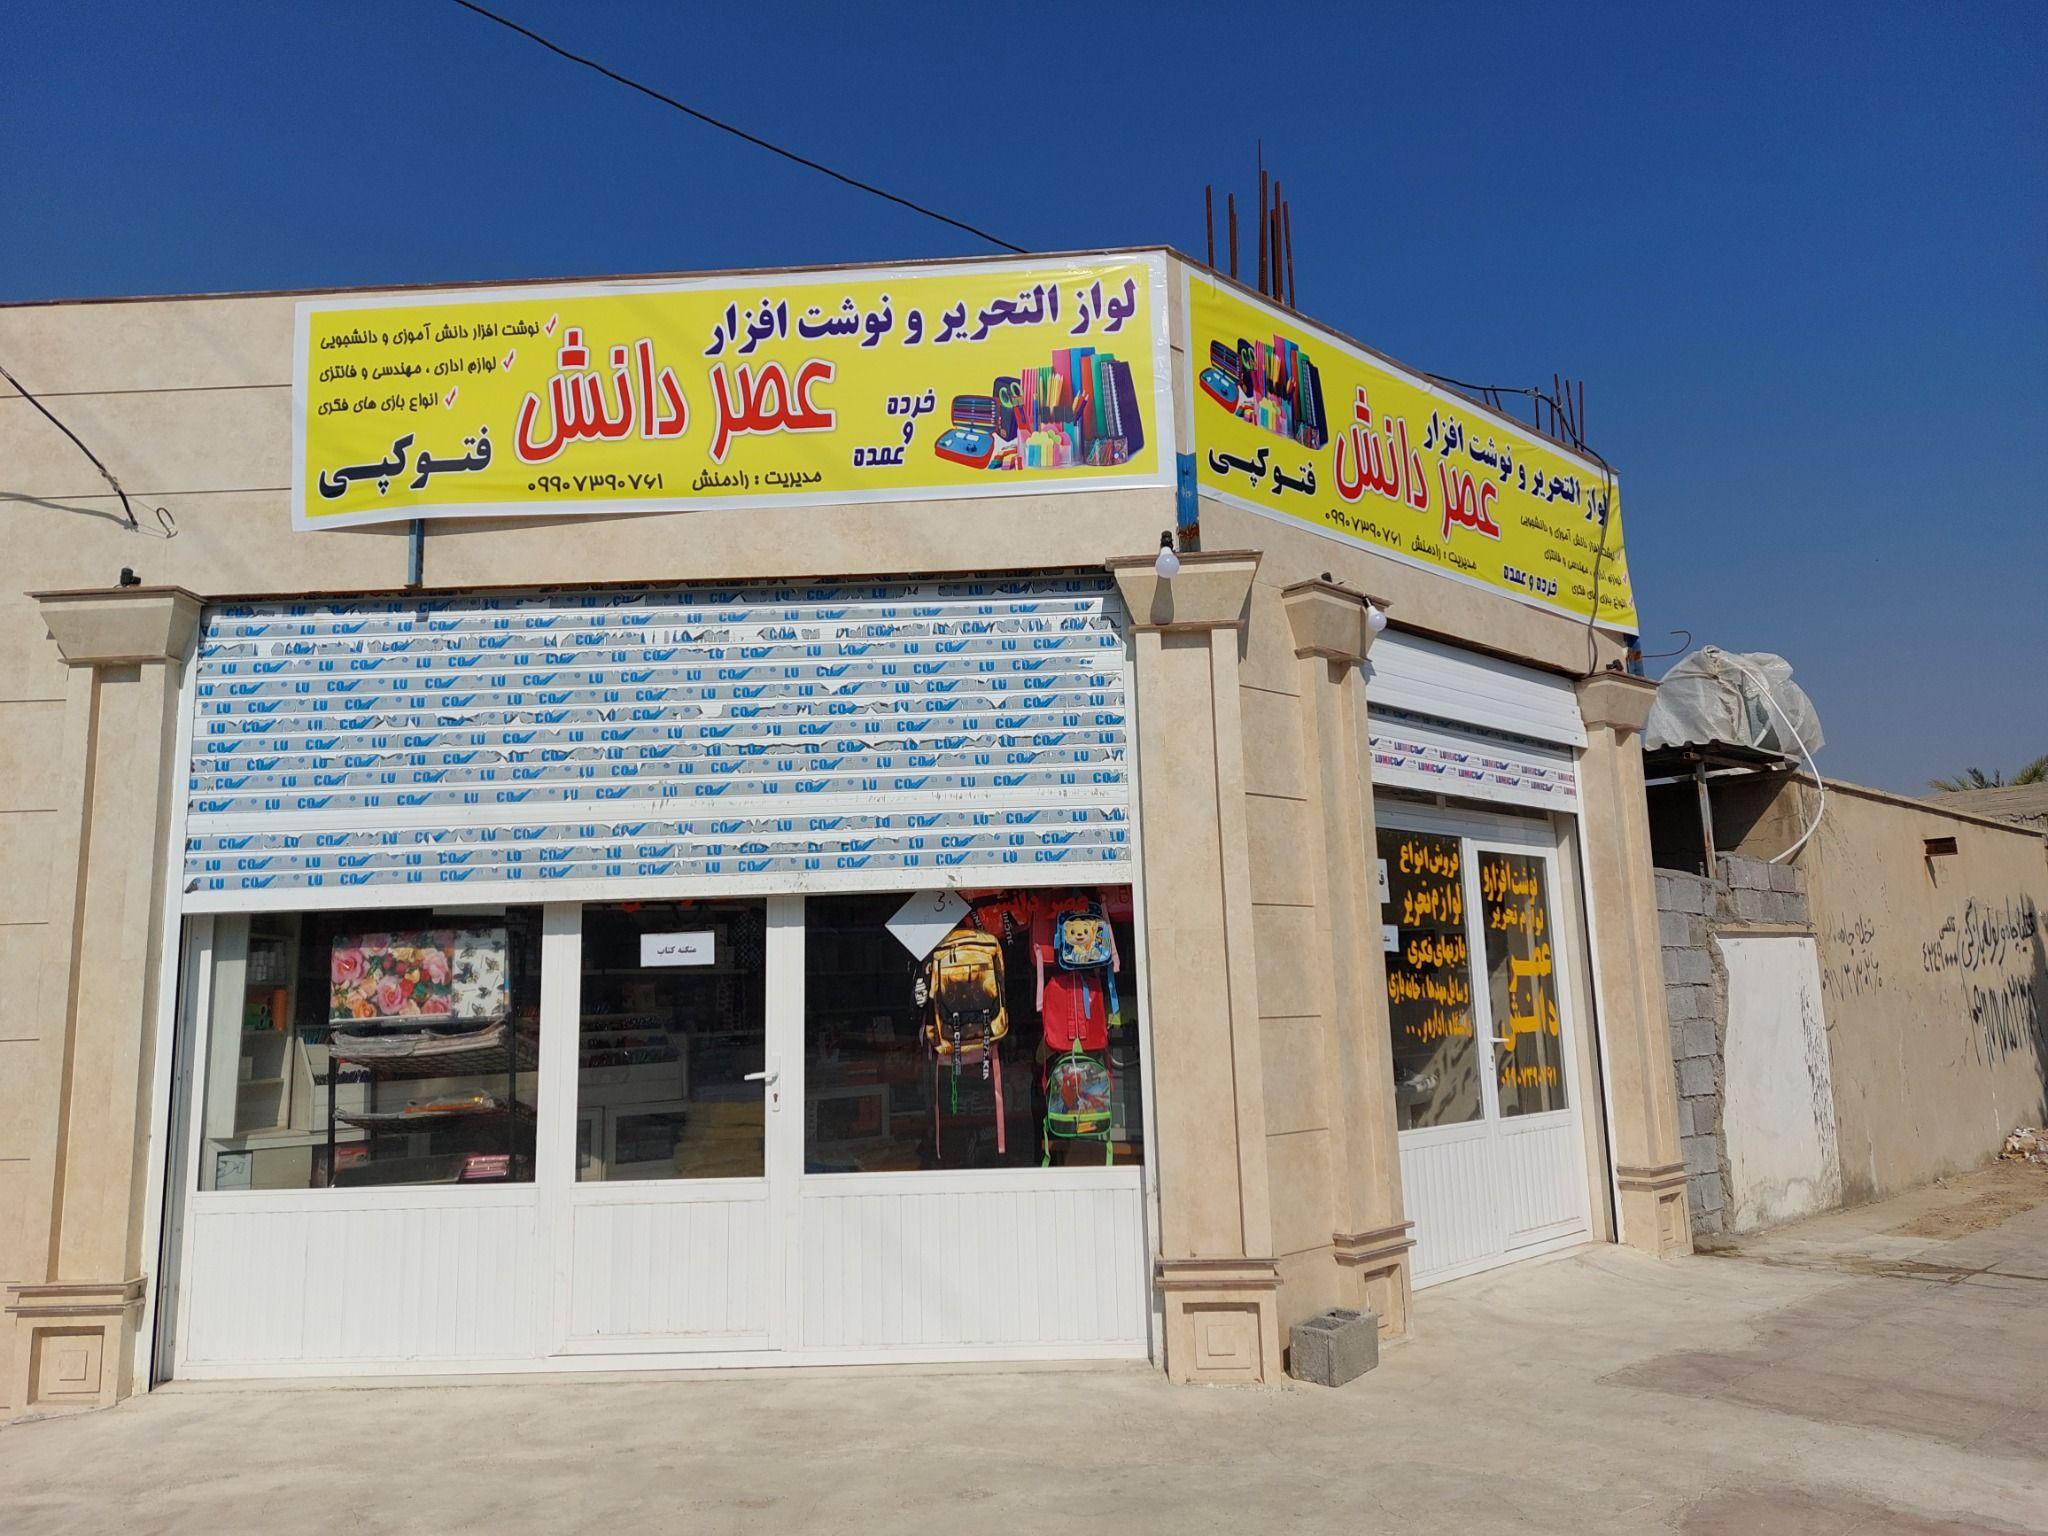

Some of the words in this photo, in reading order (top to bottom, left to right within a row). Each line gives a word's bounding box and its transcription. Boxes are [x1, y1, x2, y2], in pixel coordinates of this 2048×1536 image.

[935, 283, 1059, 345] التحریر
[1072, 278, 1136, 334] لواز
[473, 323, 498, 339] افزار
[502, 320, 539, 335] نوشت
[705, 299, 787, 356] افزار
[799, 295, 893, 346] نوشت
[905, 314, 923, 344] و
[320, 328, 378, 349] دانشجویی
[382, 332, 389, 345] و
[393, 322, 431, 344] آموزی
[435, 324, 468, 342] دانش
[319, 362, 358, 382] فانتزی
[361, 367, 369, 380] و
[372, 362, 422, 380] مهندسی
[434, 359, 464, 377] اداری
[468, 356, 497, 374] لوازم
[318, 397, 349, 415] فکری
[352, 397, 377, 413] های
[381, 395, 406, 413] بازی
[410, 392, 438, 412] انواع
[516, 330, 686, 462] دانش
[887, 388, 935, 414] خرده
[712, 360, 834, 461] عصر
[902, 421, 914, 445] و
[1423, 408, 1464, 457] افزار
[853, 446, 905, 467] عمده
[1335, 387, 1429, 511] دانش
[1469, 434, 1513, 481] نوشت
[318, 426, 492, 499] فتوکپی
[1208, 446, 1317, 497] فتوکپی
[528, 472, 664, 492] ۰۹۹۰۷۳۹۰۷۶۱
[692, 470, 749, 491] رادمنش
[765, 470, 822, 487] مدیریت
[1518, 461, 1528, 491] و
[1530, 464, 1581, 507] التحریر
[1441, 463, 1500, 542] عصر
[1411, 535, 1442, 559] رادمنش
[1448, 550, 1477, 570] مدیریت
[1503, 565, 1526, 586] عمده
[1529, 572, 1535, 592] و
[1536, 576, 1558, 597] خرده
[1400, 841, 1429, 874] انواع
[1430, 843, 1459, 878] فروش
[1487, 860, 1511, 902] افزار
[1512, 867, 1538, 906] نوشت
[1403, 880, 1431, 926] تحریر
[1431, 882, 1462, 925] لوازم
[657, 945, 676, 957] کتاب
[1407, 936, 1433, 969] فکری
[1509, 942, 1551, 993] عصر
[1501, 985, 1560, 1052] دانش
